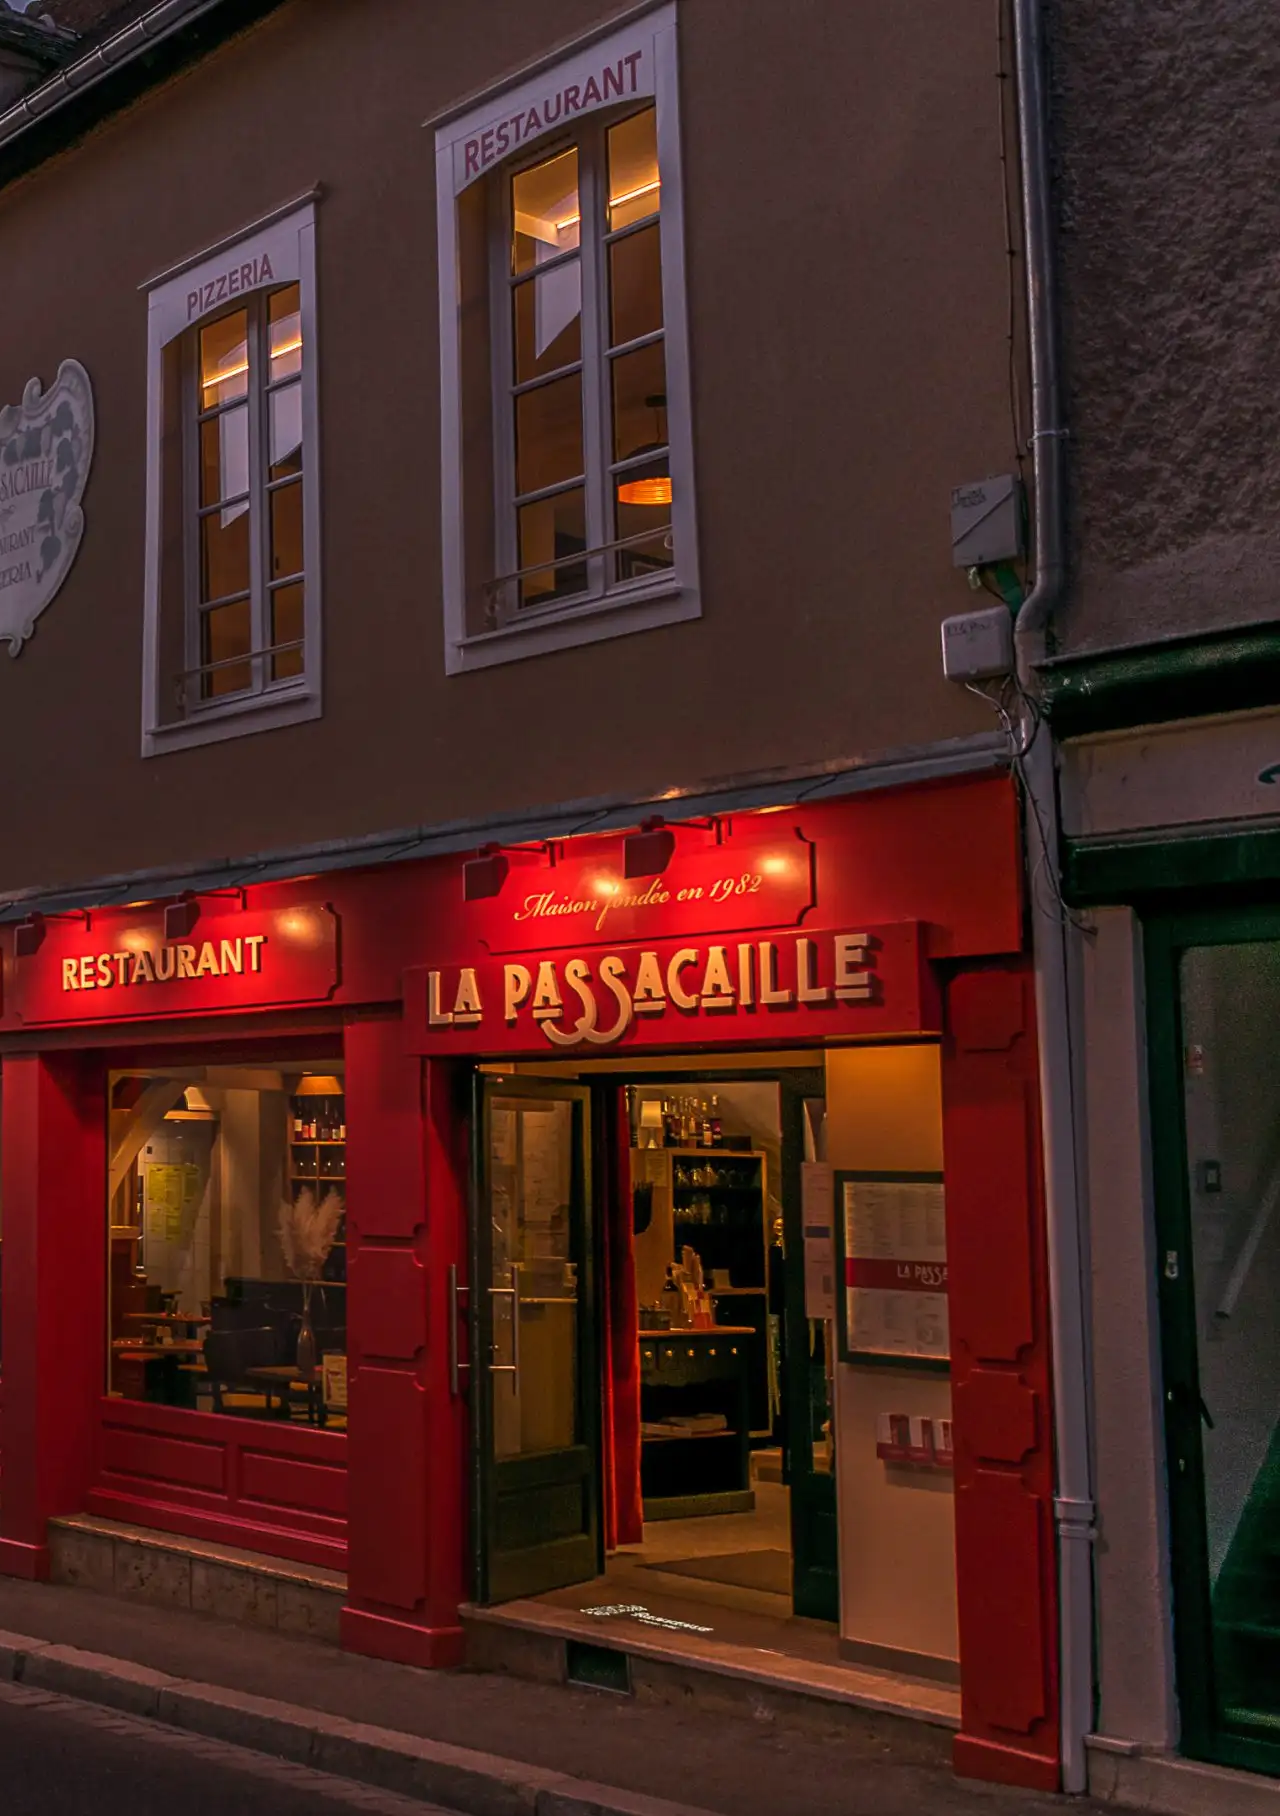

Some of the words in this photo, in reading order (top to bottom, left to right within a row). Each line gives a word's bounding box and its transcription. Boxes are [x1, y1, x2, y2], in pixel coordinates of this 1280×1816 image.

[463, 50, 642, 180] RESTAURANT
[187, 253, 274, 320] PIZZERIA
[514, 890, 597, 921] Maison
[595, 878, 670, 931] fondée
[676, 885, 704, 901] en
[708, 873, 763, 904] 1982
[62, 935, 265, 991] RESTAURANT
[428, 968, 484, 1025] LA
[503, 933, 871, 1045] PASSACAILLE
[897, 1263, 911, 1279] LA
